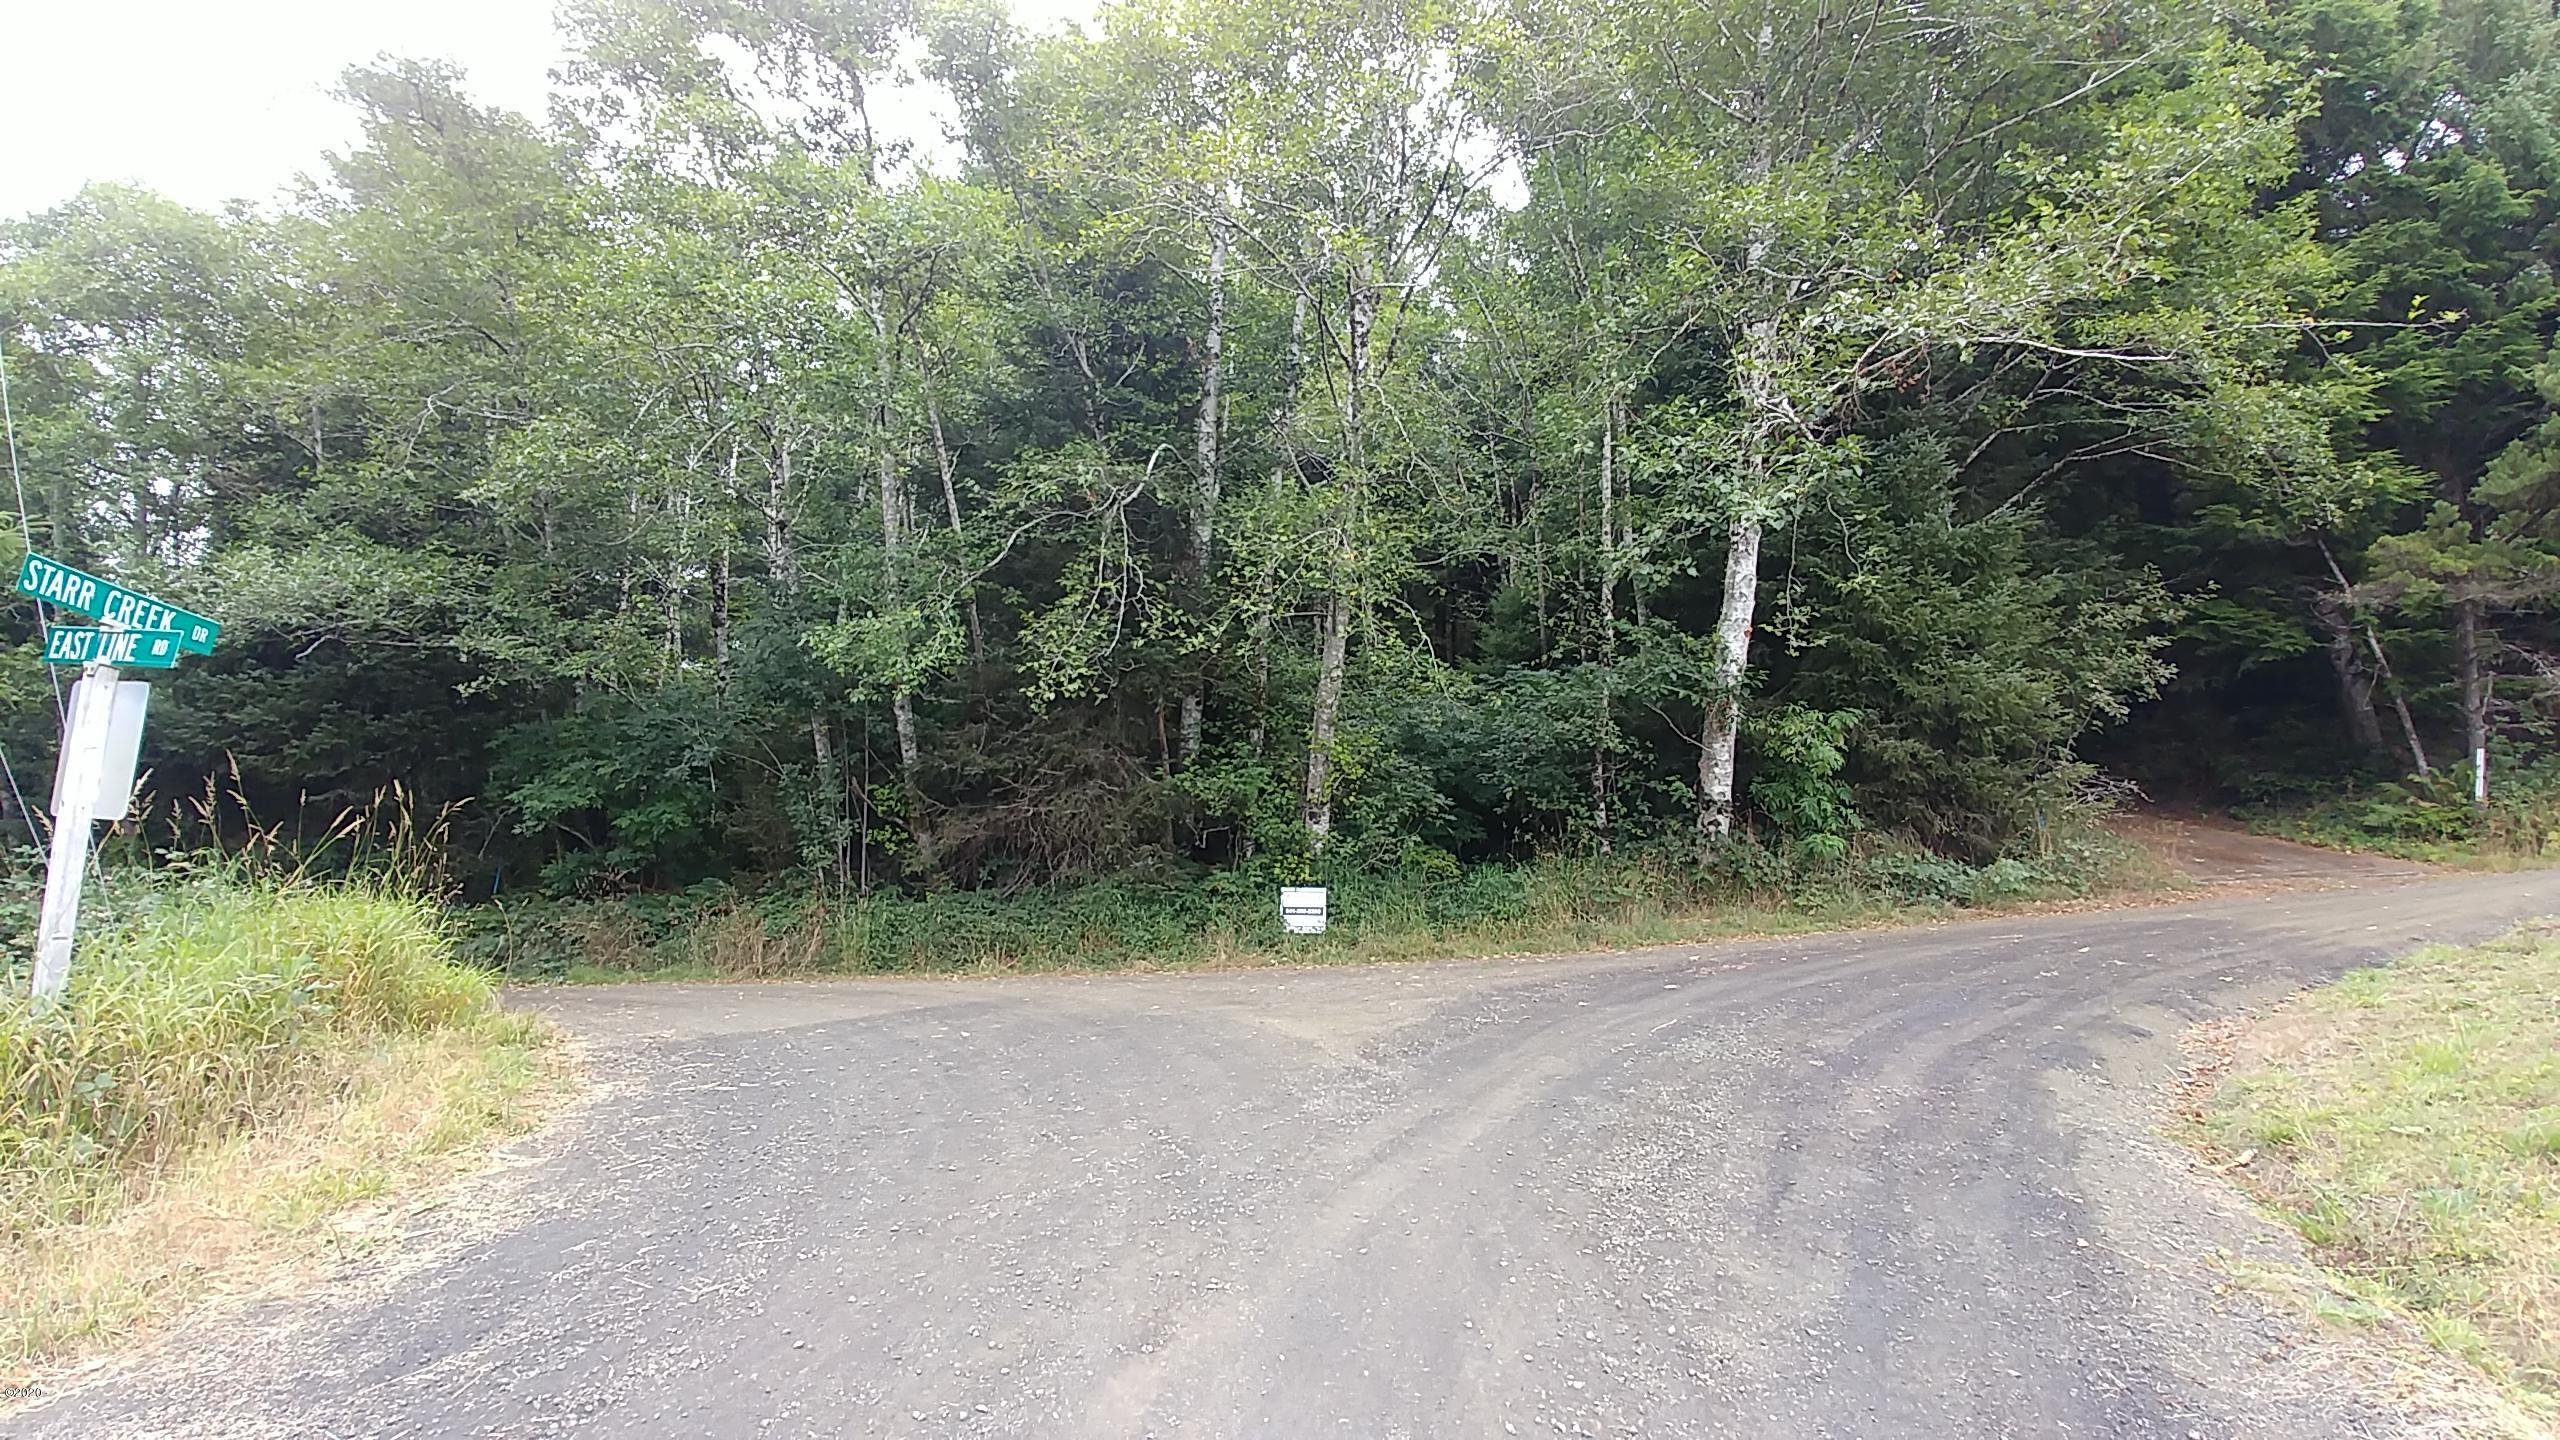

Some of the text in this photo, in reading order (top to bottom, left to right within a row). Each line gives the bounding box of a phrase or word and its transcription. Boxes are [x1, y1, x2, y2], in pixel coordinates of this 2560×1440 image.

[23, 559, 208, 643] STARR CREEK DR
[48, 630, 170, 662] EAST LINE RD
